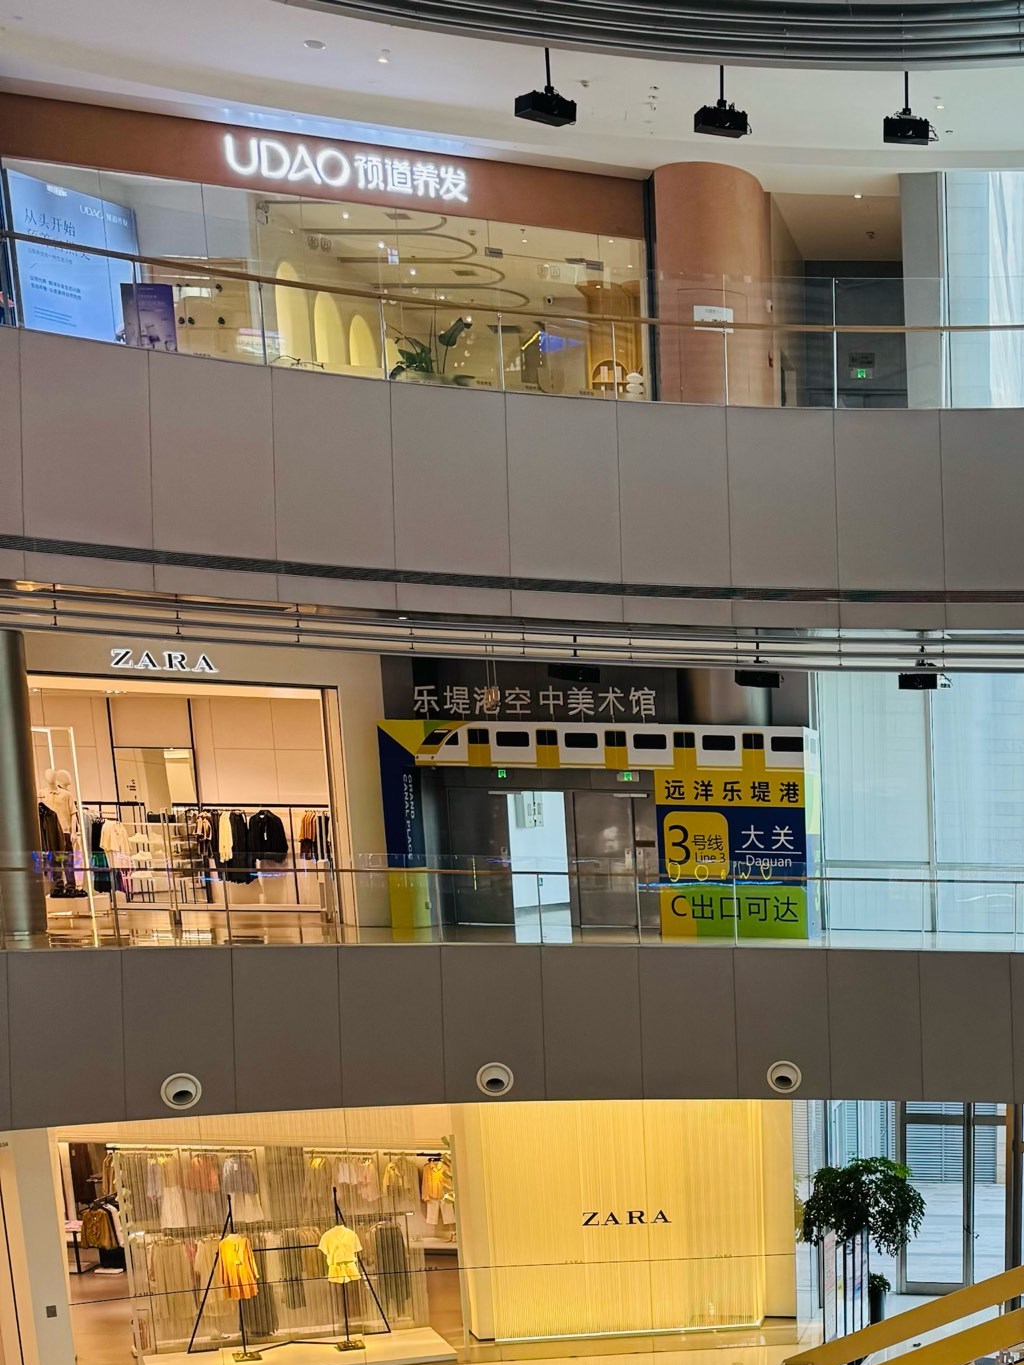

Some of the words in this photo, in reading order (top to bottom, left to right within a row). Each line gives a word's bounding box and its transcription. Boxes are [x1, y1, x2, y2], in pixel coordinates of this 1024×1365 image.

[224, 133, 349, 187] UDAO
[355, 155, 468, 203] 预道养发
[25, 208, 76, 237] 从头开始
[111, 648, 219, 673] ZARA
[665, 780, 800, 803] 远洋乐堤港
[741, 825, 794, 850] 大关
[695, 852, 716, 863] Line
[719, 853, 726, 863] 3
[746, 855, 792, 870] Daguan
[671, 895, 799, 922] C出口可达
[582, 1210, 672, 1226] ZARA
